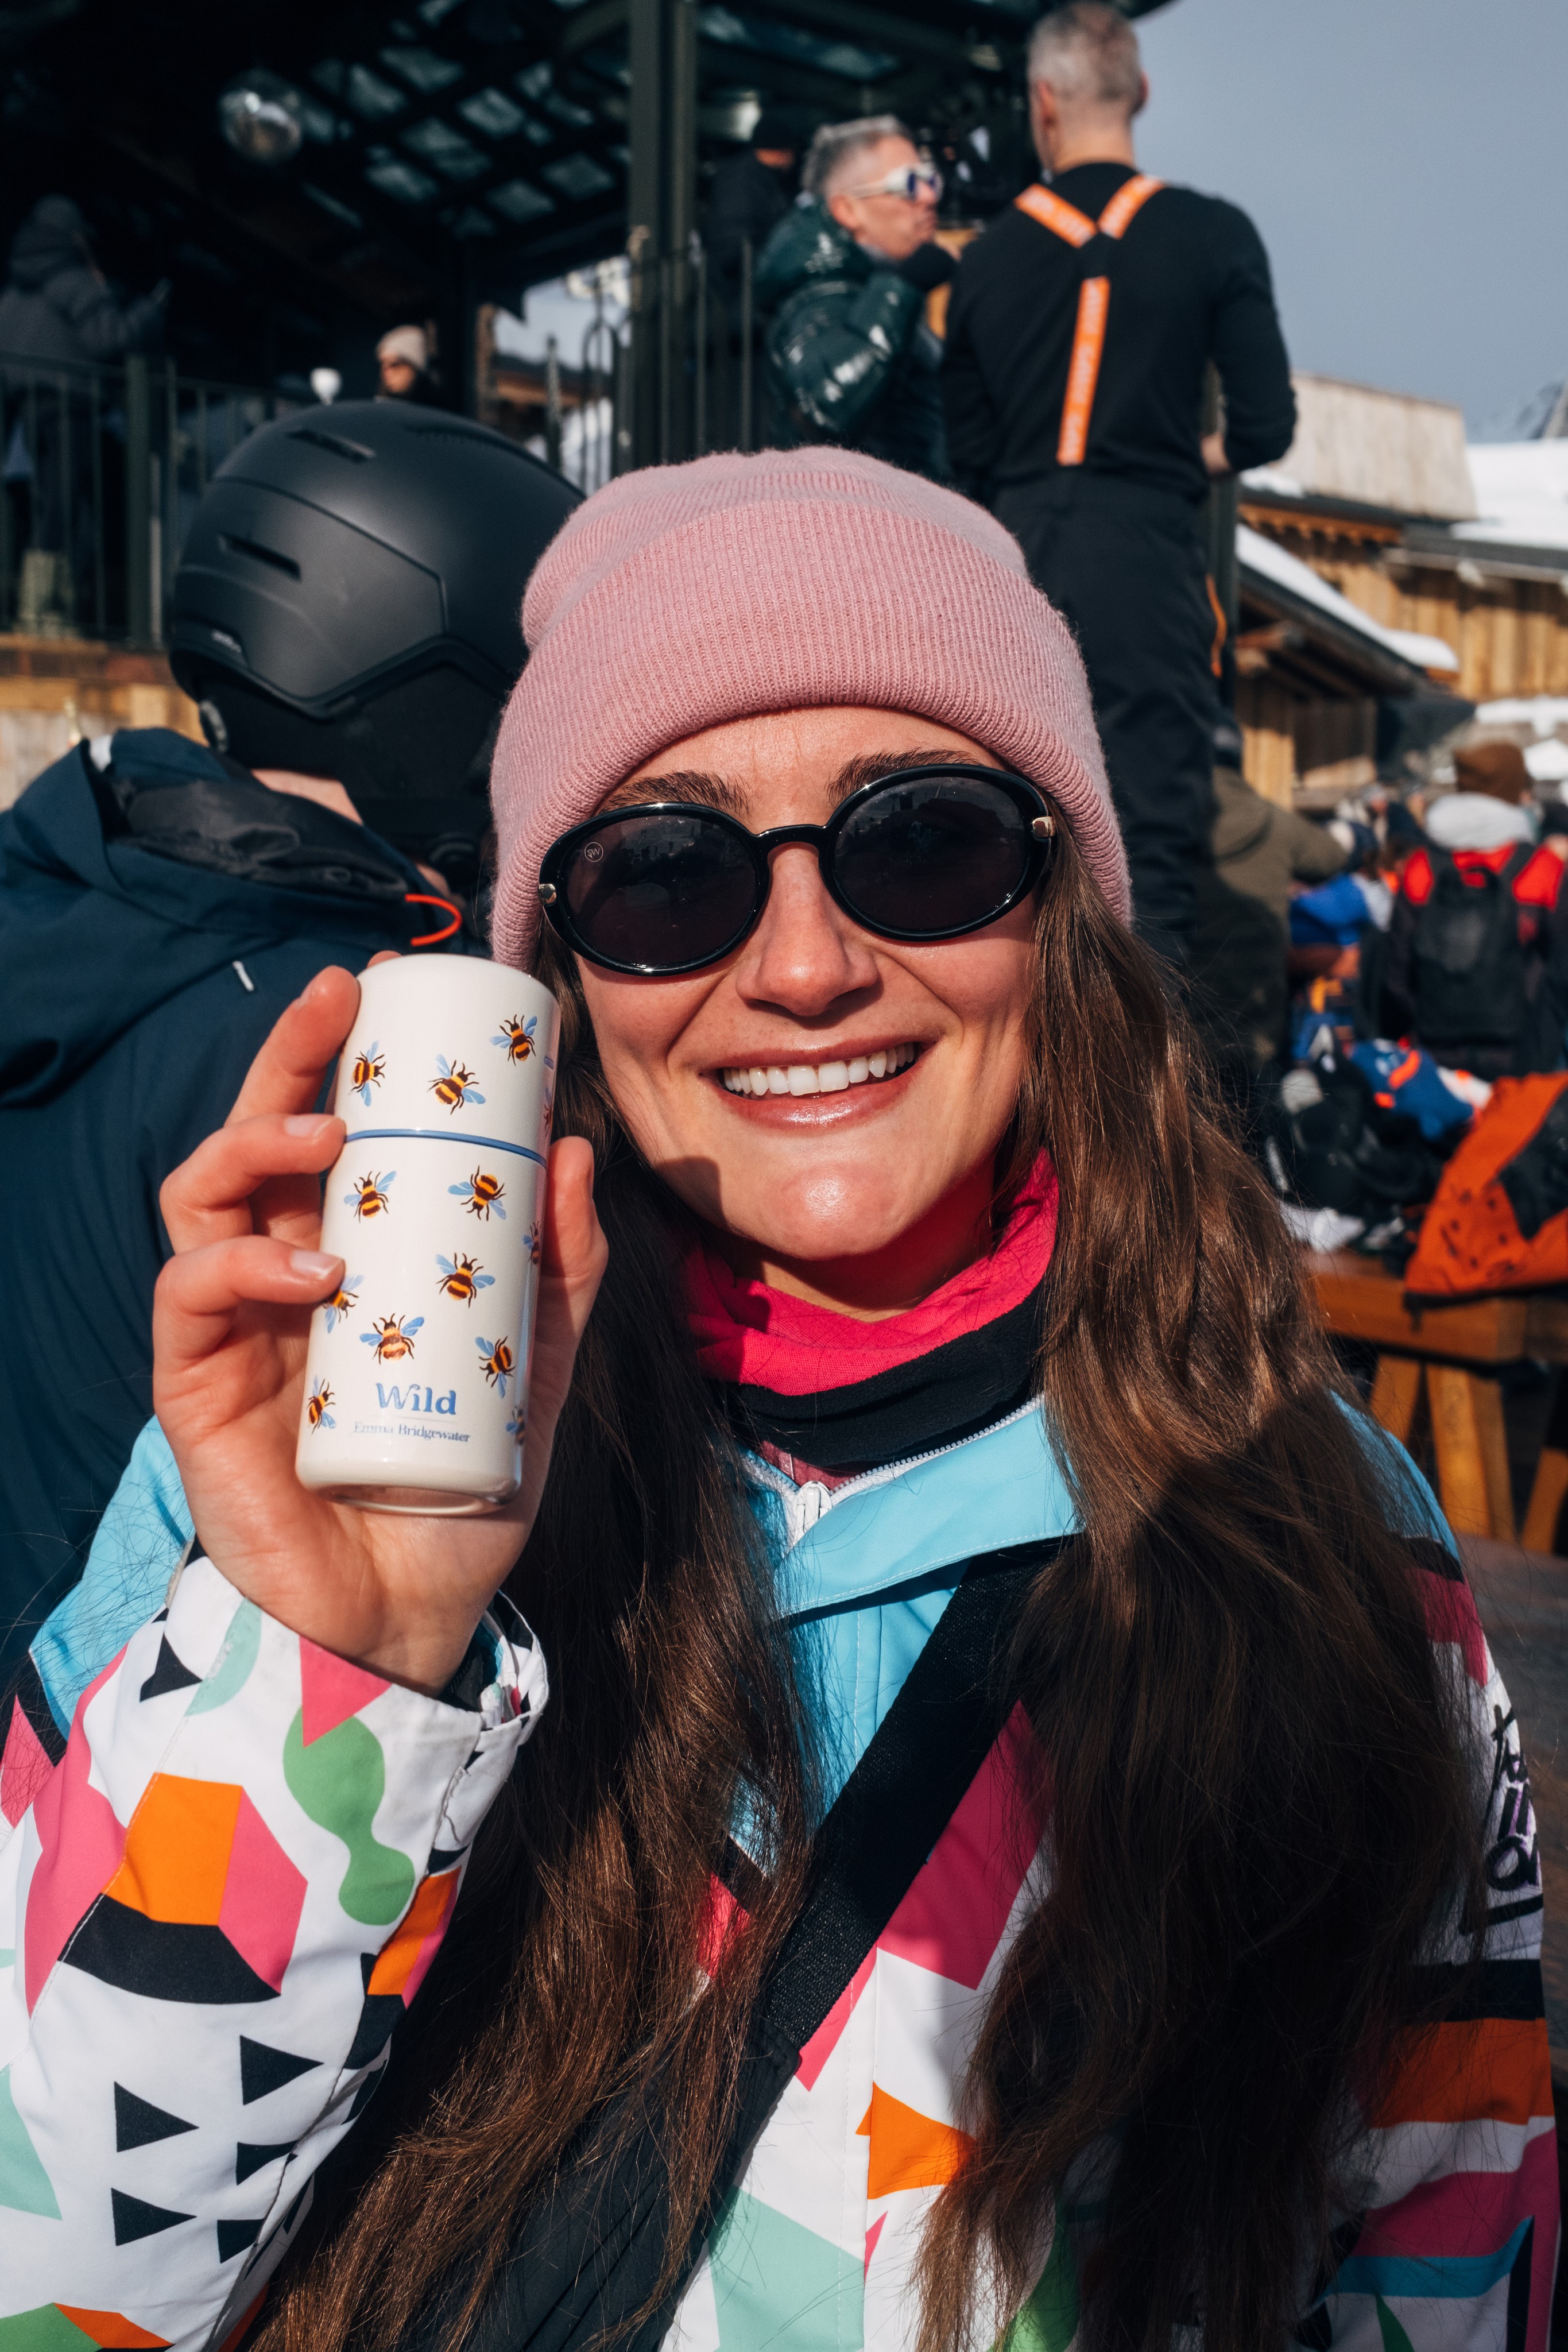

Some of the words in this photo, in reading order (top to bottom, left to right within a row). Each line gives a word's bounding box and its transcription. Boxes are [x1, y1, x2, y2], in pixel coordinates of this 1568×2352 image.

[375, 1383, 456, 1415] Wild
[354, 1421, 394, 1434] Emma
[398, 1423, 470, 1442] Bridgewater
